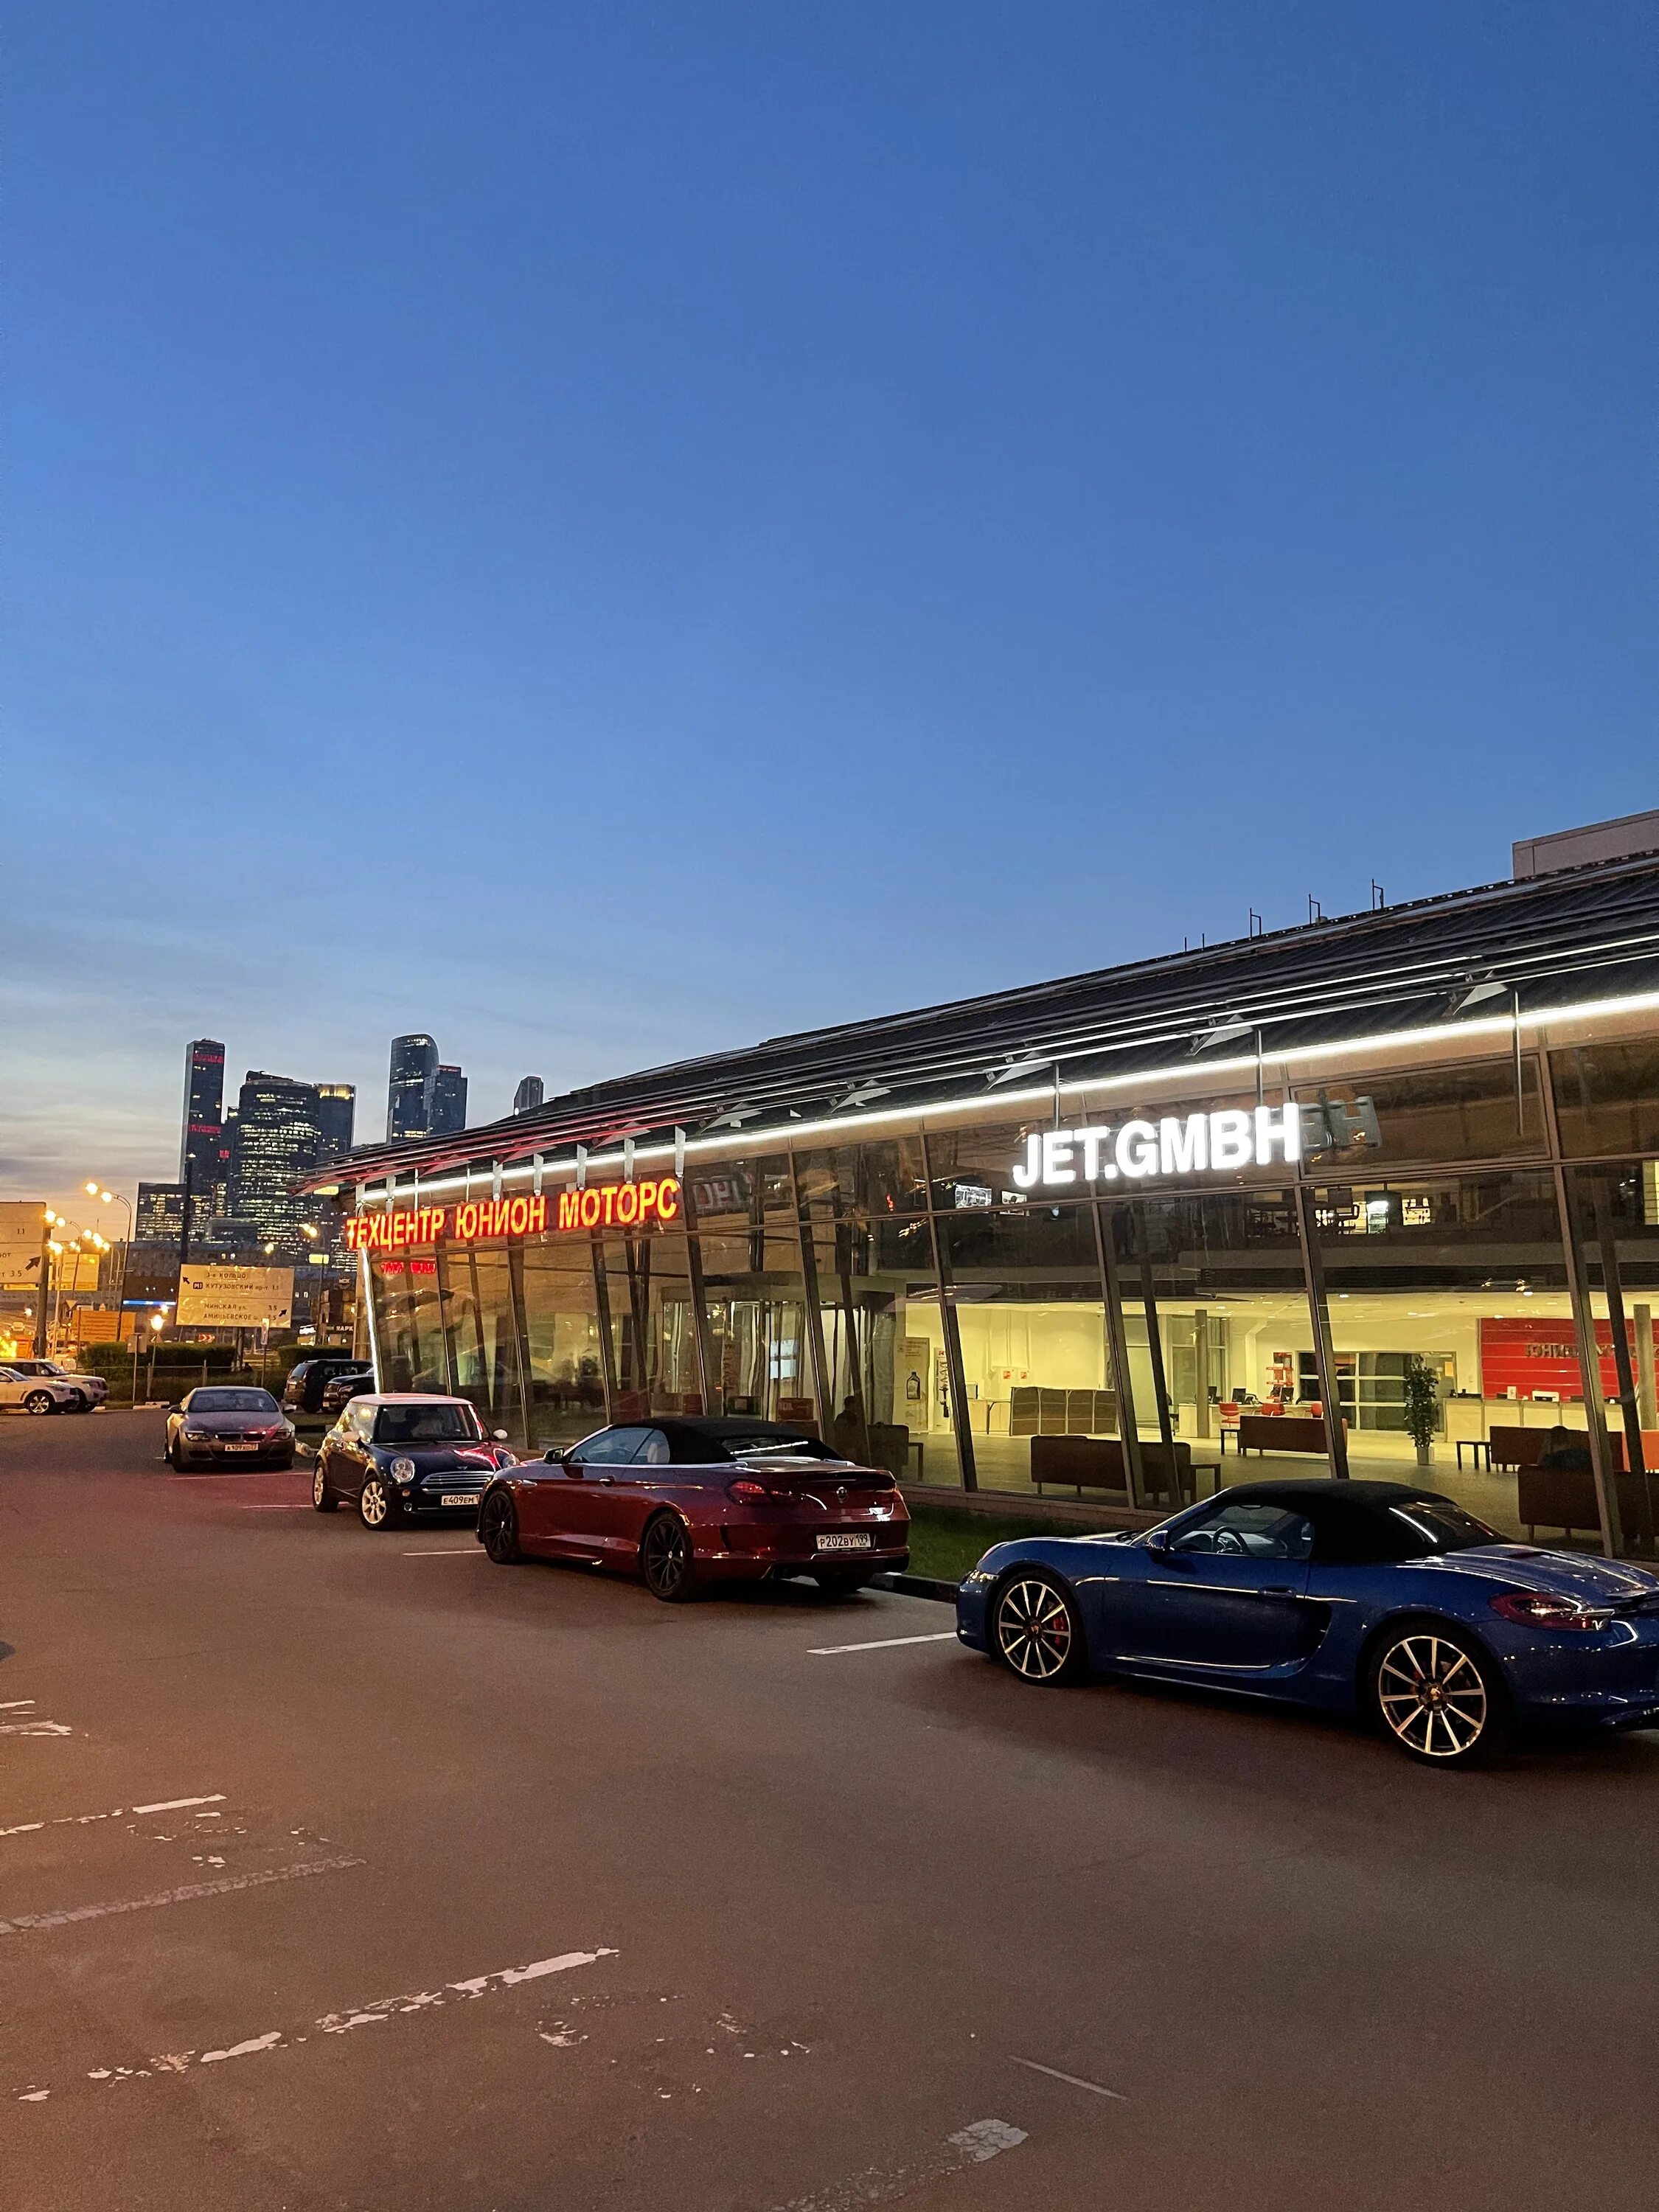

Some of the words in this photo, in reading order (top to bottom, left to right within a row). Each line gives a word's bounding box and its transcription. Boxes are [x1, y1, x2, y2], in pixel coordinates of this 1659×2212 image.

[1012, 1102, 1300, 1188] JET.GMBH
[346, 1208, 445, 1251] ТЕХЦЕНТР
[455, 1195, 546, 1239] ЮНИОН
[558, 1177, 679, 1229] МОТОРС
